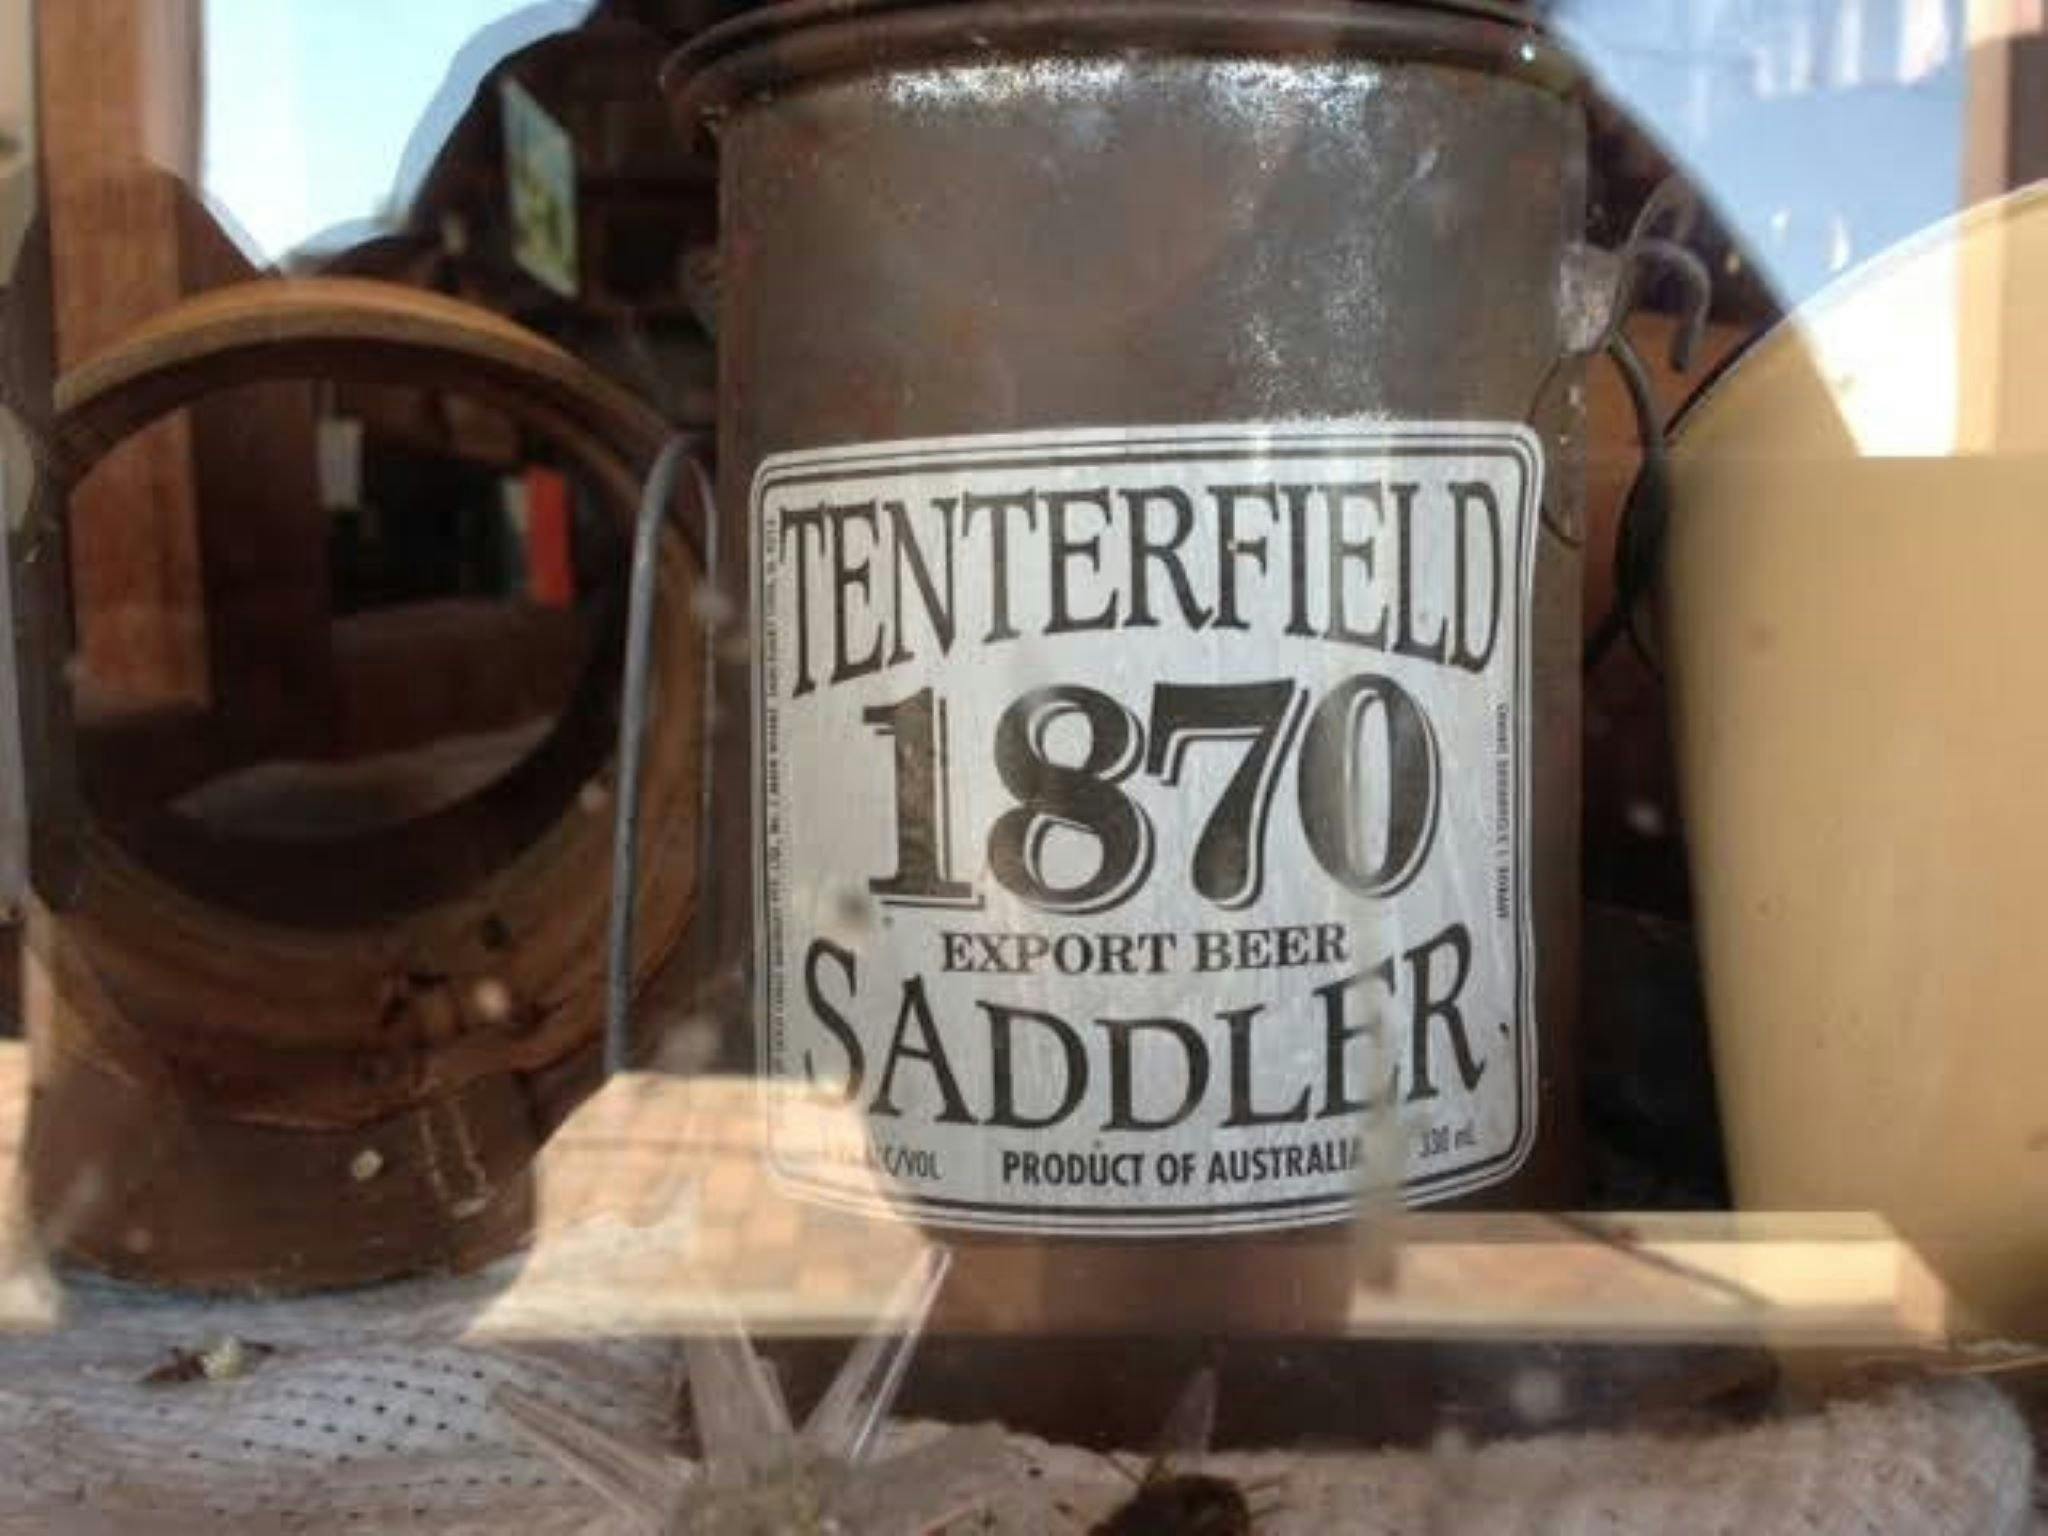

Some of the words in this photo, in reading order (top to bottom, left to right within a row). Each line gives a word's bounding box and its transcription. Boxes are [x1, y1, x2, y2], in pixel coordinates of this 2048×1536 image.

[778, 480, 1503, 698] TENTERFIELD
[862, 673, 1443, 914] 1870
[803, 922, 1488, 1132] SADDLER
[941, 931, 1177, 973] EXPORT
[1192, 923, 1349, 970] BEER
[1002, 1148, 1147, 1186] PRODUCT
[1155, 1151, 1197, 1185] OF
